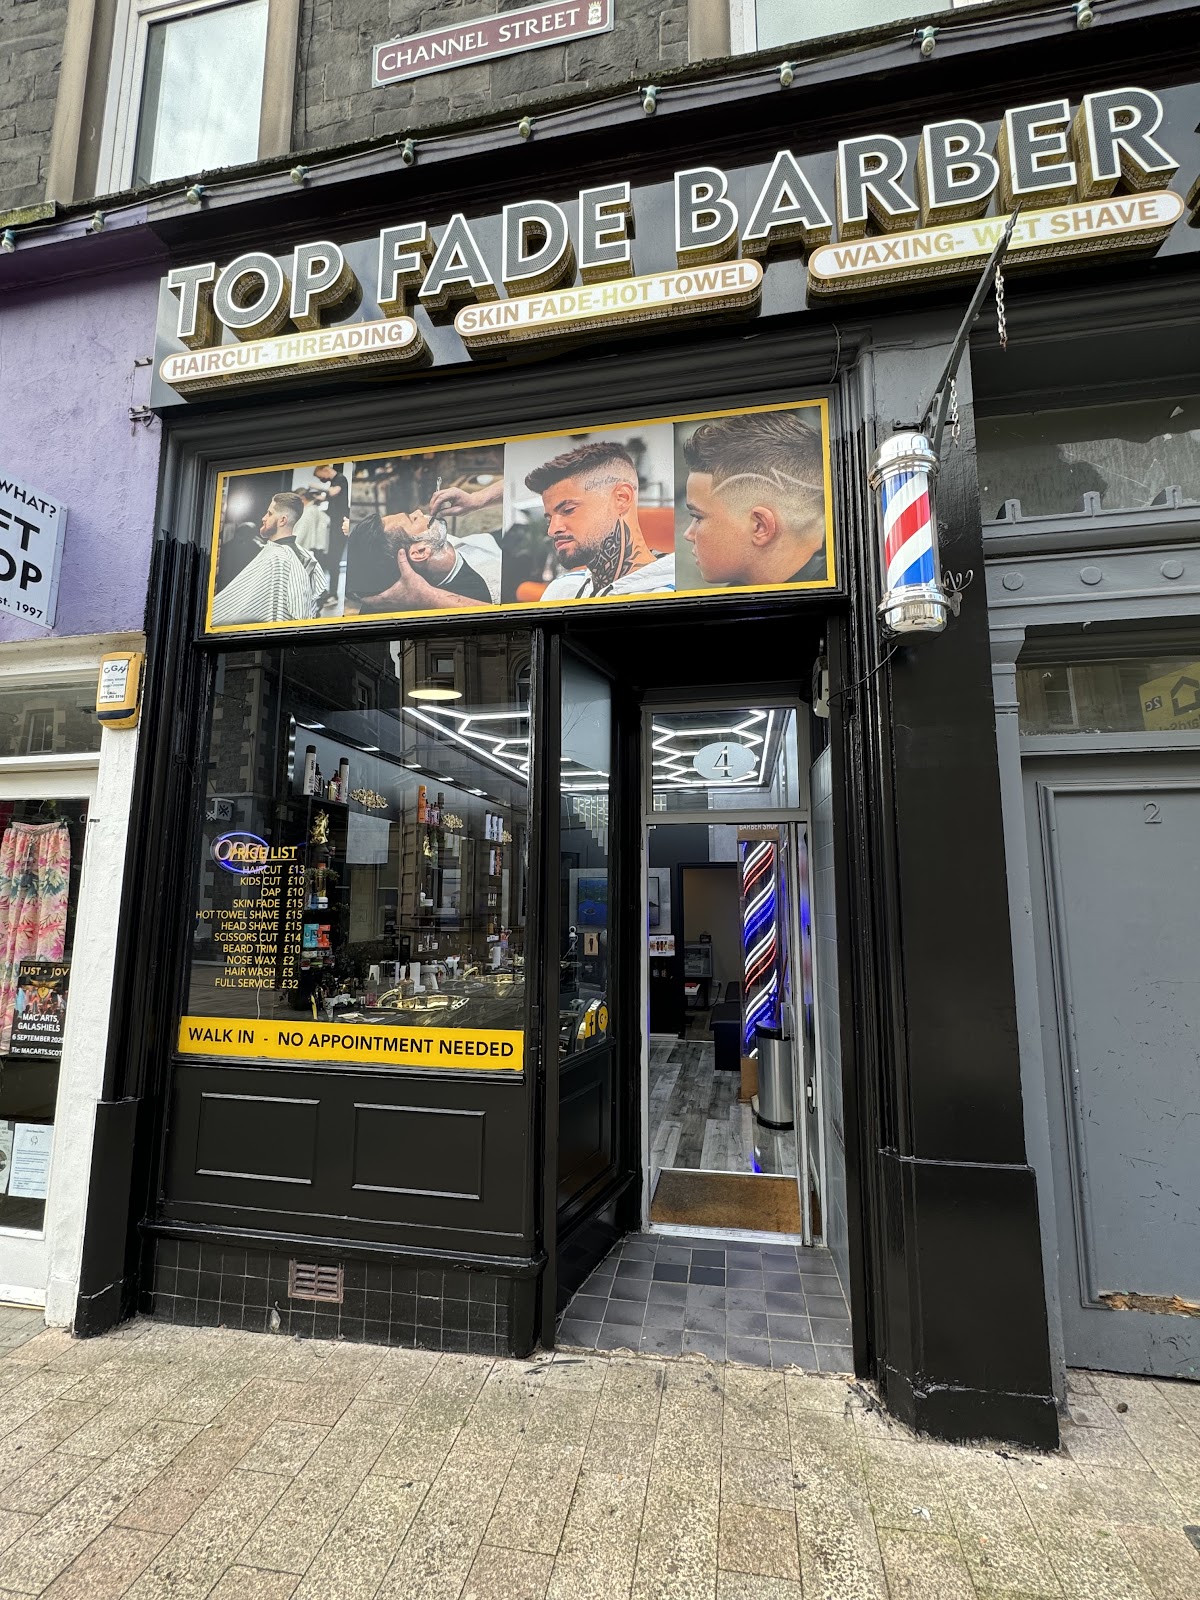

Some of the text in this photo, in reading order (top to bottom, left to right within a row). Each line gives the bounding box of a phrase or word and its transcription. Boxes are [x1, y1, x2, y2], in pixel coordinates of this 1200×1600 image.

[381, 8, 580, 71] CHANNEL STREET
[168, 87, 1180, 338] TOP FADE BARBER
[1051, 199, 1158, 235] SHAVE
[462, 303, 520, 330] SKIN
[660, 266, 753, 297] TOWEL
[275, 322, 403, 366] THREADING
[0, 479, 57, 518] WHAT?
[16, 601, 43, 618] 1997
[711, 745, 735, 778] 4
[1143, 801, 1163, 824] 2
[230, 846, 298, 860] PRICE LIST
[242, 865, 305, 875] HAIRCUT £13
[240, 877, 305, 886] KIDS CUT £10
[261, 888, 304, 897] OAP £10
[233, 899, 303, 908] SKIN FADE £15
[195, 910, 303, 919] HOT TOWEL SHAVE £15
[221, 922, 302, 931] HEAD SHAVE £15
[214, 933, 301, 942] SCISSORS CUT £14
[222, 944, 300, 954] BEARD TRIM £10
[226, 956, 295, 966] NOSE WAX £2
[19, 966, 70, 979] JUST JOV
[224, 967, 294, 977] HAIR WASH £5
[214, 978, 299, 989] FULL SERVICE £32
[22, 1013, 60, 1024] MAC ARTS,
[17, 1022, 60, 1032] GALASHIELS
[17, 1034, 51, 1042] SEPTEMBER
[188, 1027, 233, 1043] WALK
[238, 1030, 255, 1045] IN
[278, 1031, 304, 1047] NO
[308, 1033, 434, 1054] APPOINTMENT
[439, 1039, 514, 1057] NEEDED
